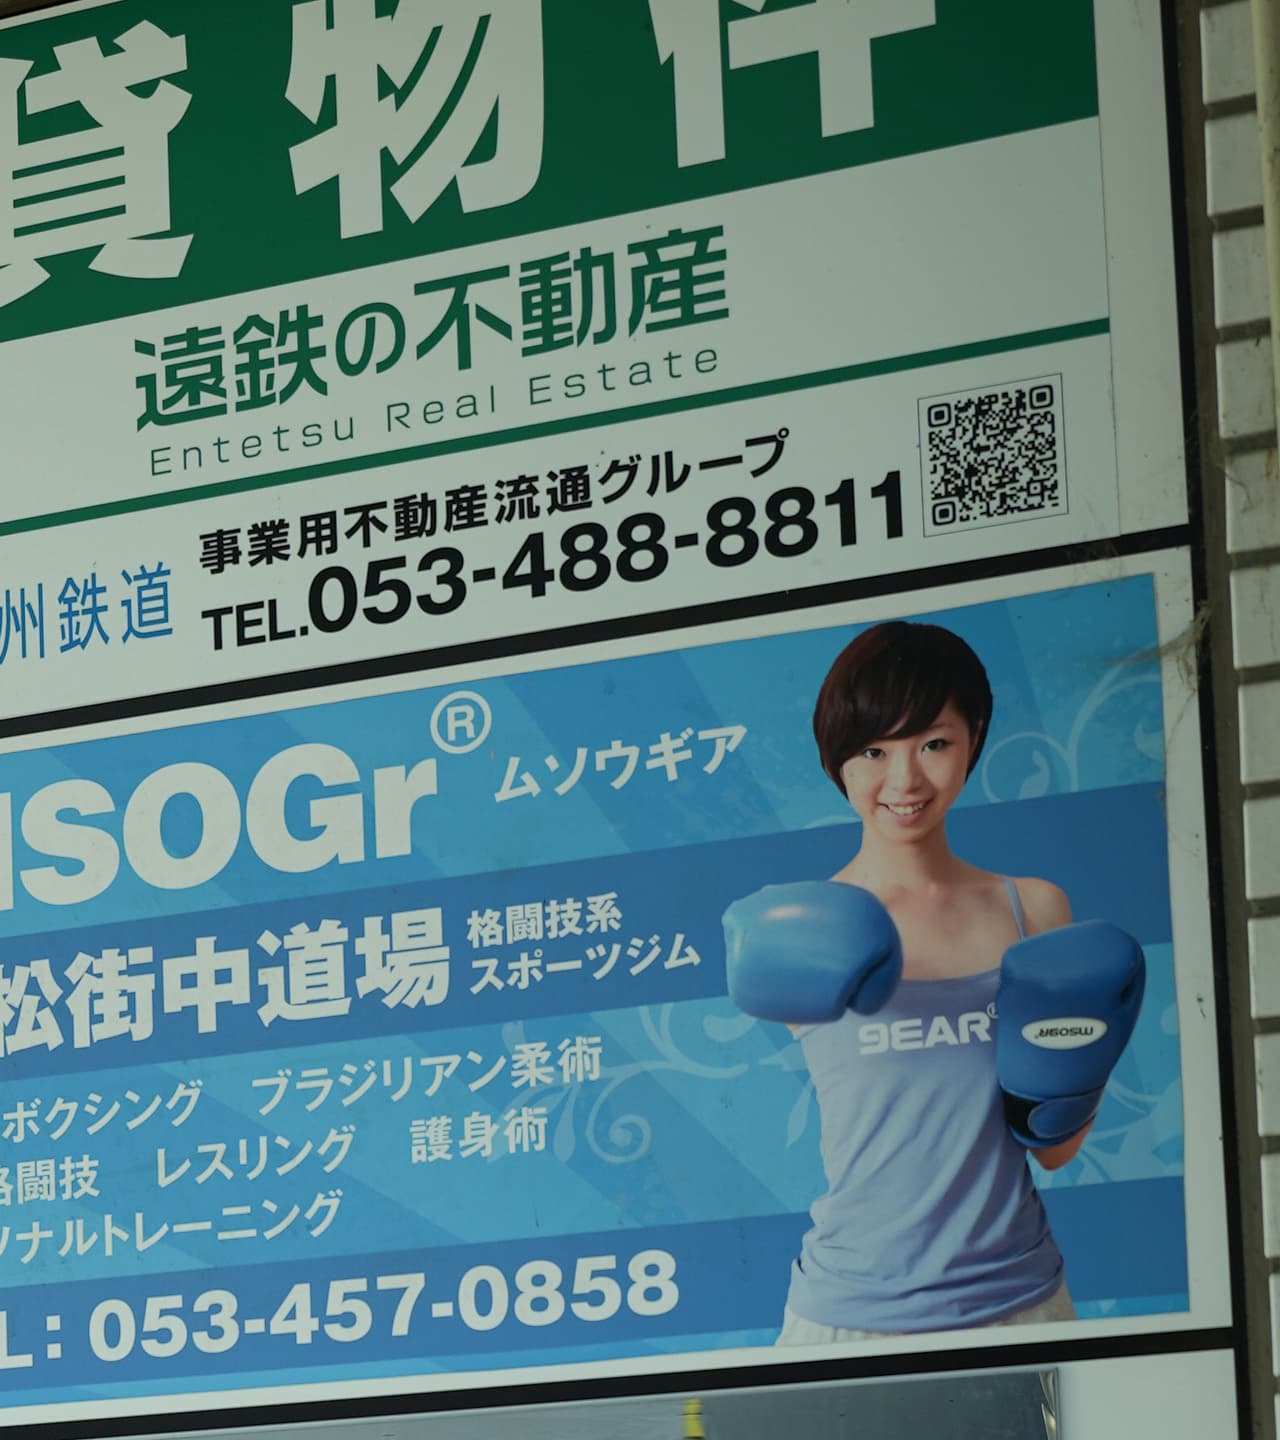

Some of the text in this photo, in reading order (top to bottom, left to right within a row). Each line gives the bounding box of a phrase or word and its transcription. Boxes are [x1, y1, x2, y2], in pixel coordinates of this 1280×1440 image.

[134, 224, 731, 433] 遠鉄の不動産
[149, 348, 721, 476] Entetsu Real Estate
[199, 427, 791, 575] 事業用不動産流通グループ
[492, 723, 748, 805] ムソウギア
[466, 892, 623, 949] 格闘技系
[468, 934, 702, 995] スポーツジム
[251, 1035, 603, 1115] ブラジリアン柔術
[156, 1123, 356, 1188] レスリング
[411, 1107, 549, 1164] 護身術
